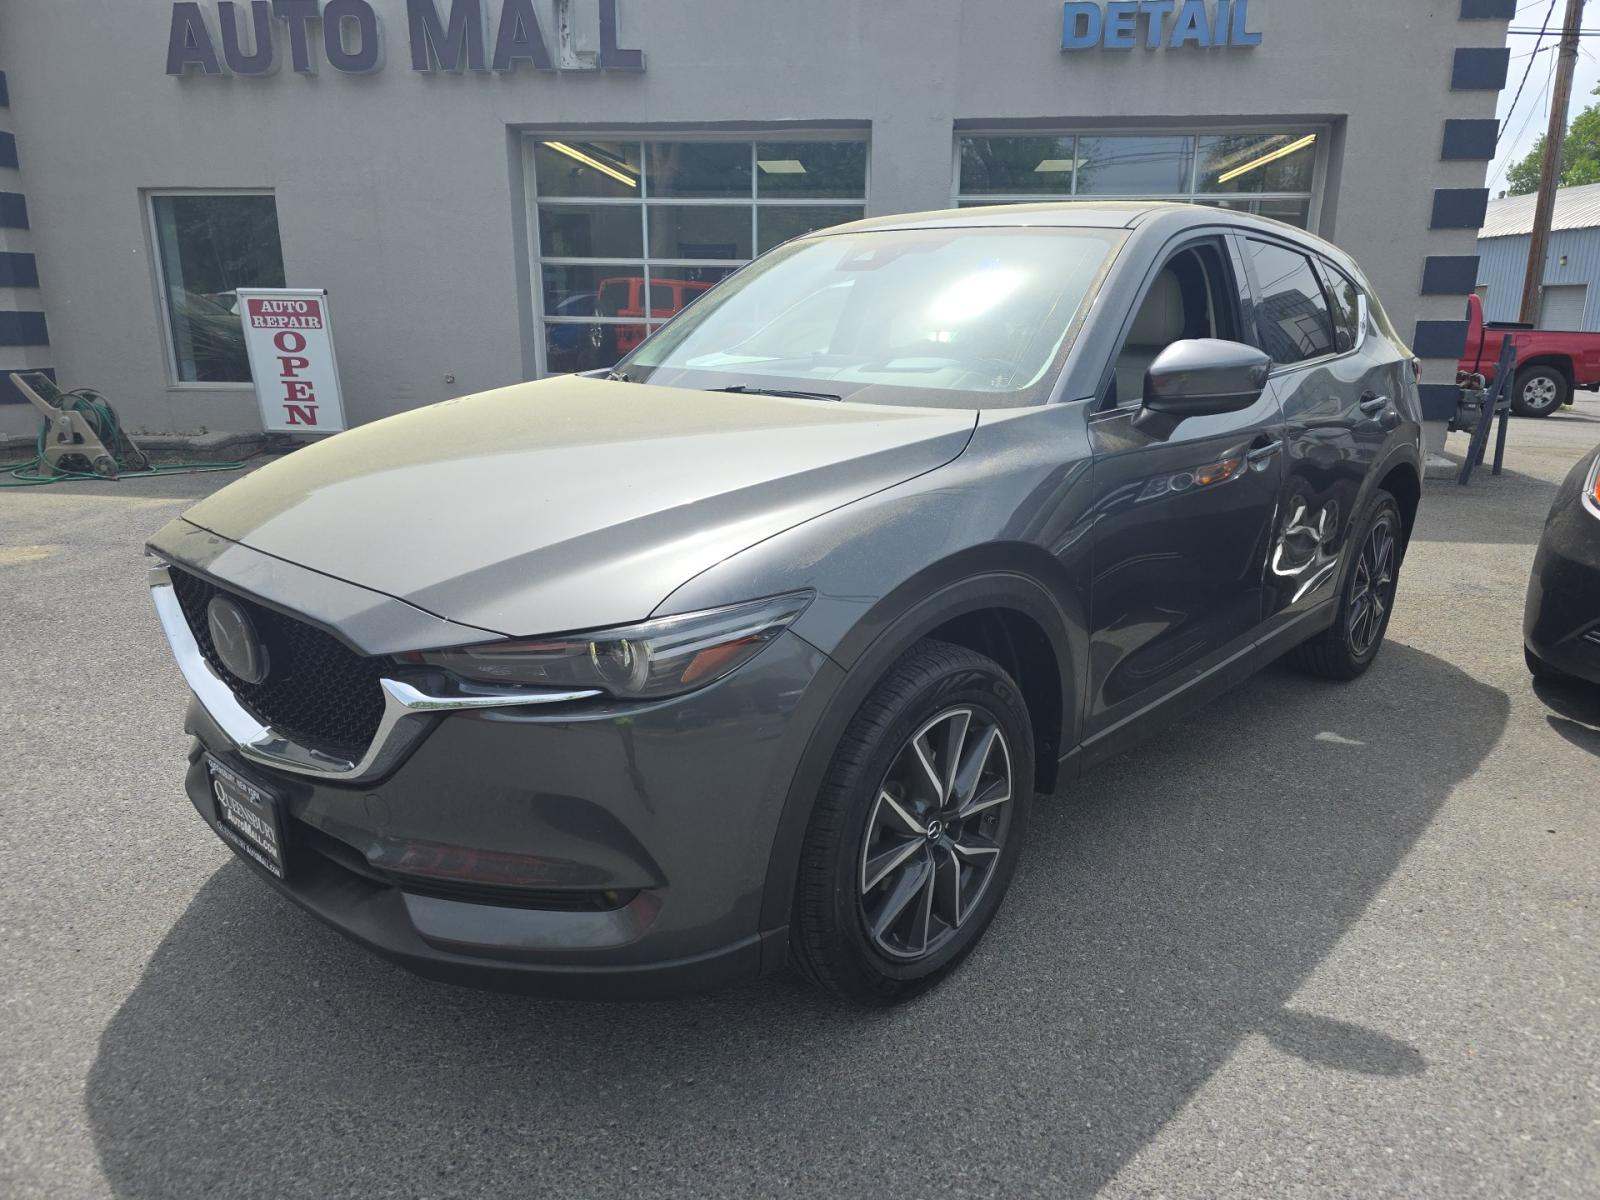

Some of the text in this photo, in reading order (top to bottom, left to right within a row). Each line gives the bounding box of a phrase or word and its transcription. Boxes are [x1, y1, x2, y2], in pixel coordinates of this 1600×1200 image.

[166, 0, 644, 75] AUTO MALL
[1061, 0, 1263, 49] DETAIL
[252, 315, 321, 328] REPAIR
[261, 300, 308, 313] AUTO
[273, 330, 320, 426] OPEN
